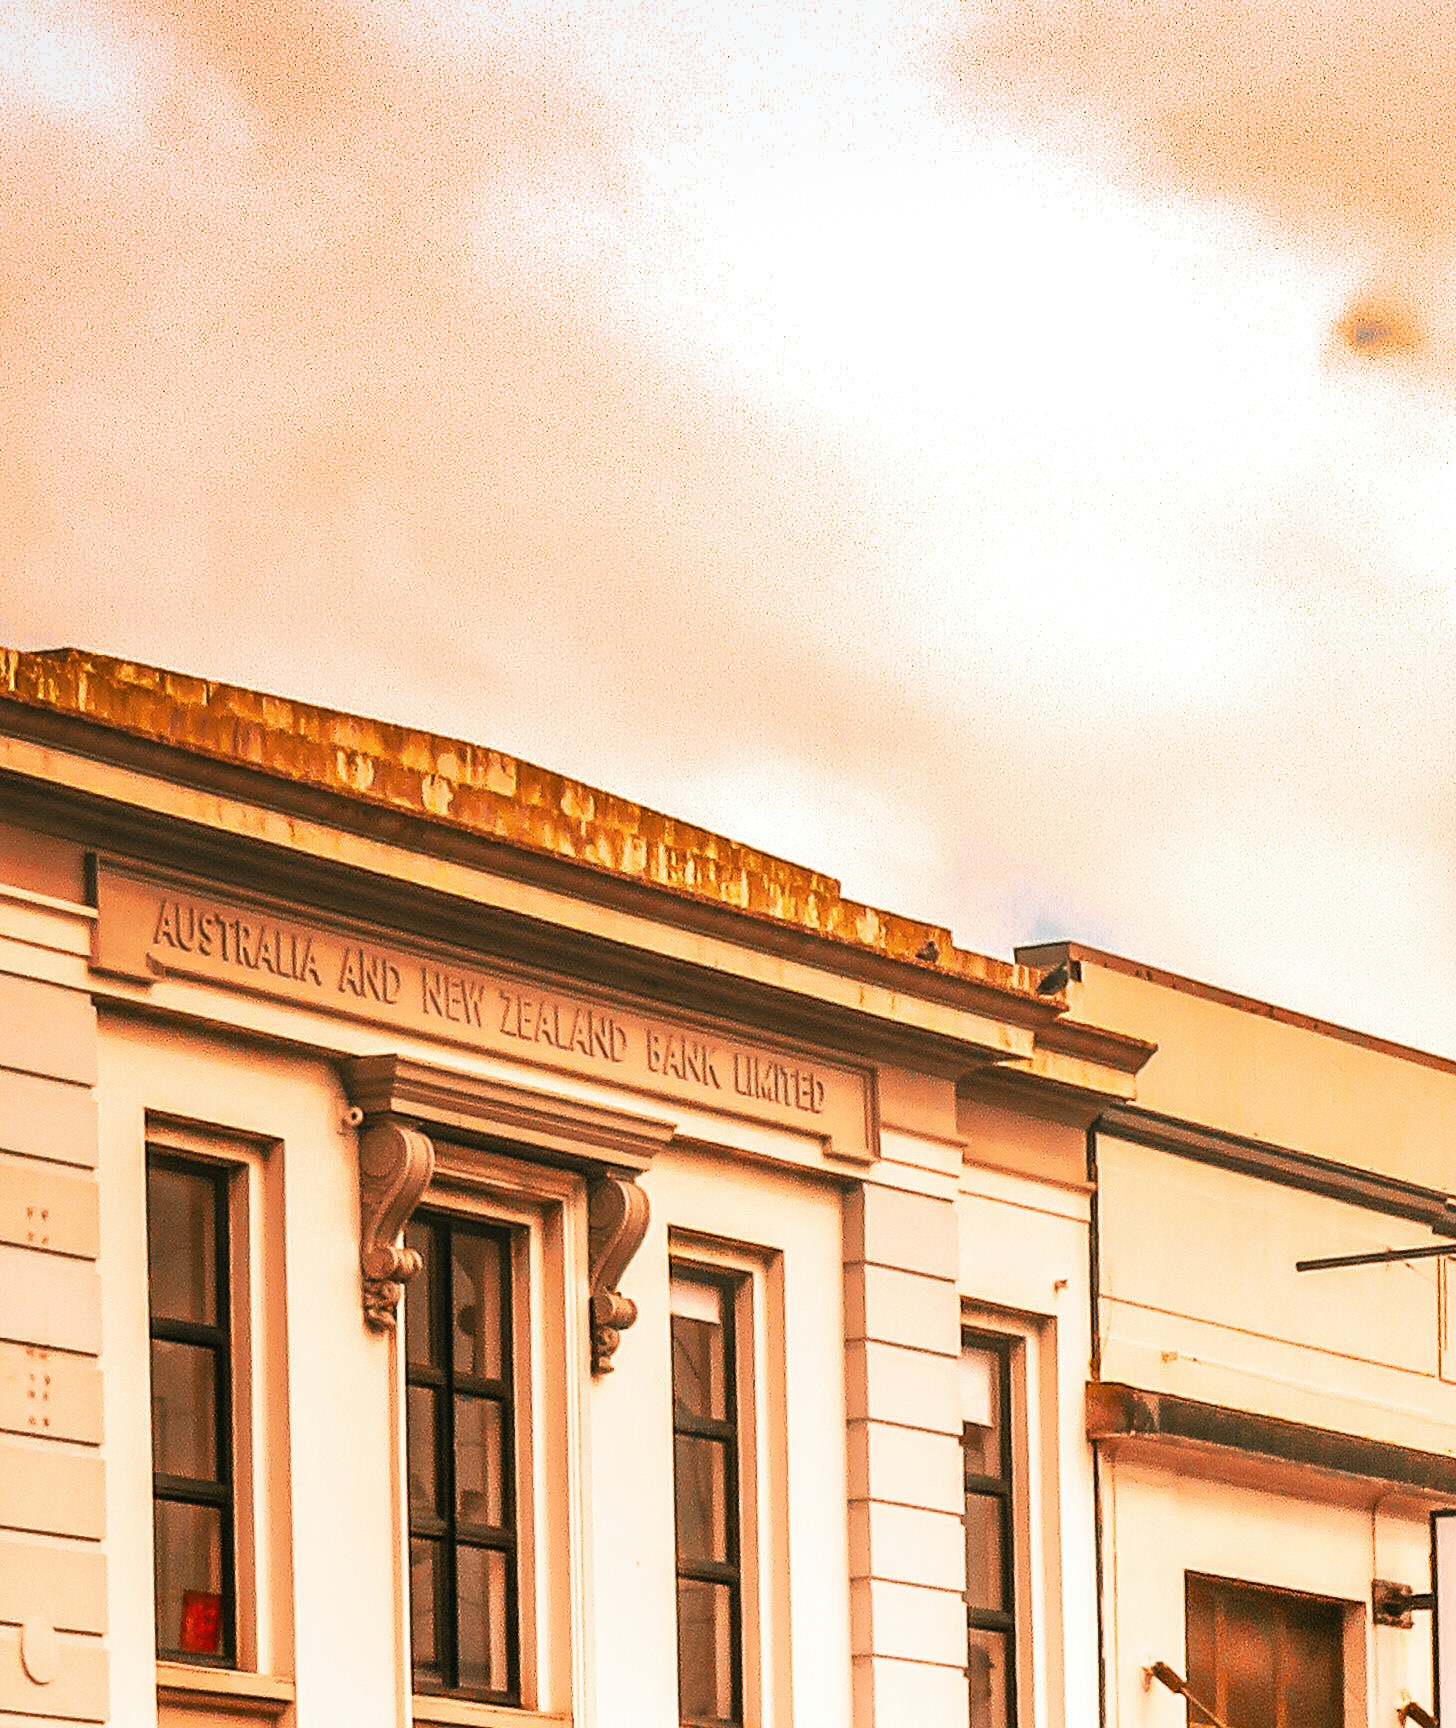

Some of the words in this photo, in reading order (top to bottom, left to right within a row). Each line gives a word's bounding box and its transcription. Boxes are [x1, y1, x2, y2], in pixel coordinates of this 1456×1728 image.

[153, 899, 322, 987] AUSTRALIA
[338, 947, 401, 1005] AND
[421, 966, 485, 1028] NEW
[499, 989, 628, 1063] ZEALAND
[645, 1028, 723, 1091] BANK
[733, 1052, 826, 1115] LIMITED
